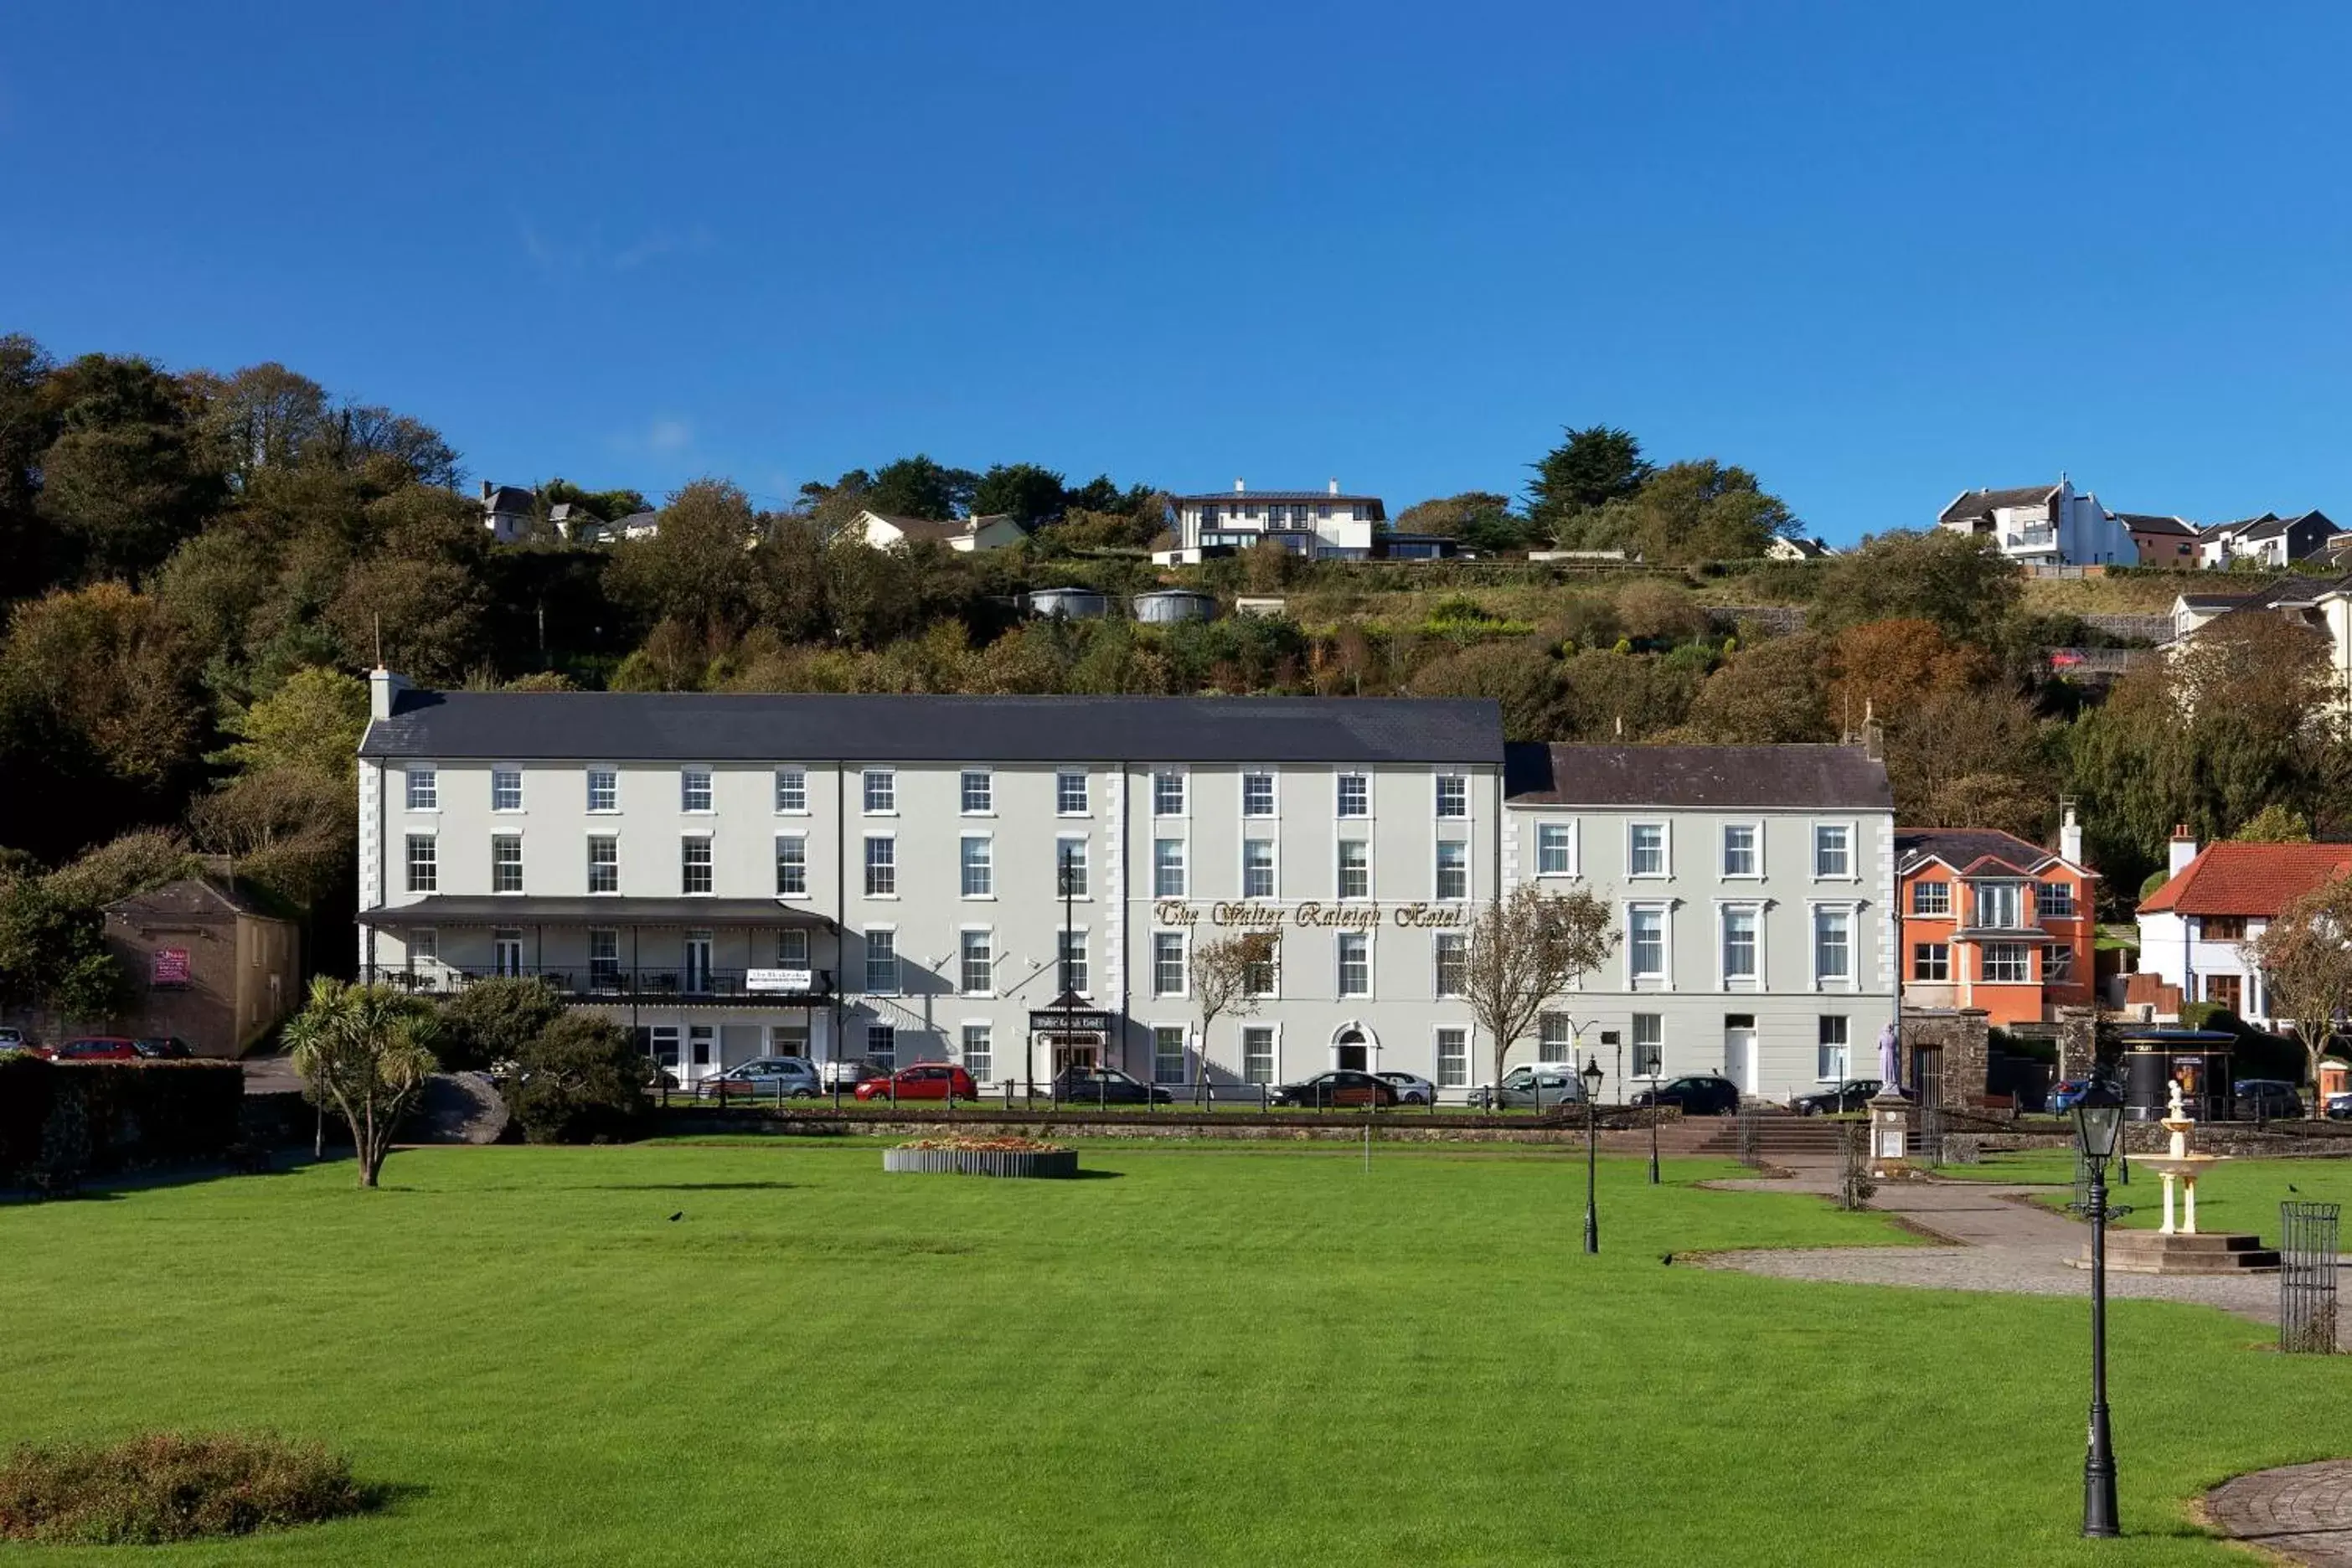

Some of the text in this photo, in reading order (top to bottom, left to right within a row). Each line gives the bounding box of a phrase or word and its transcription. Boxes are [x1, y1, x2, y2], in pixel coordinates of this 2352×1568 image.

[1157, 900, 1463, 933] The Walter Raleigh Hotel
